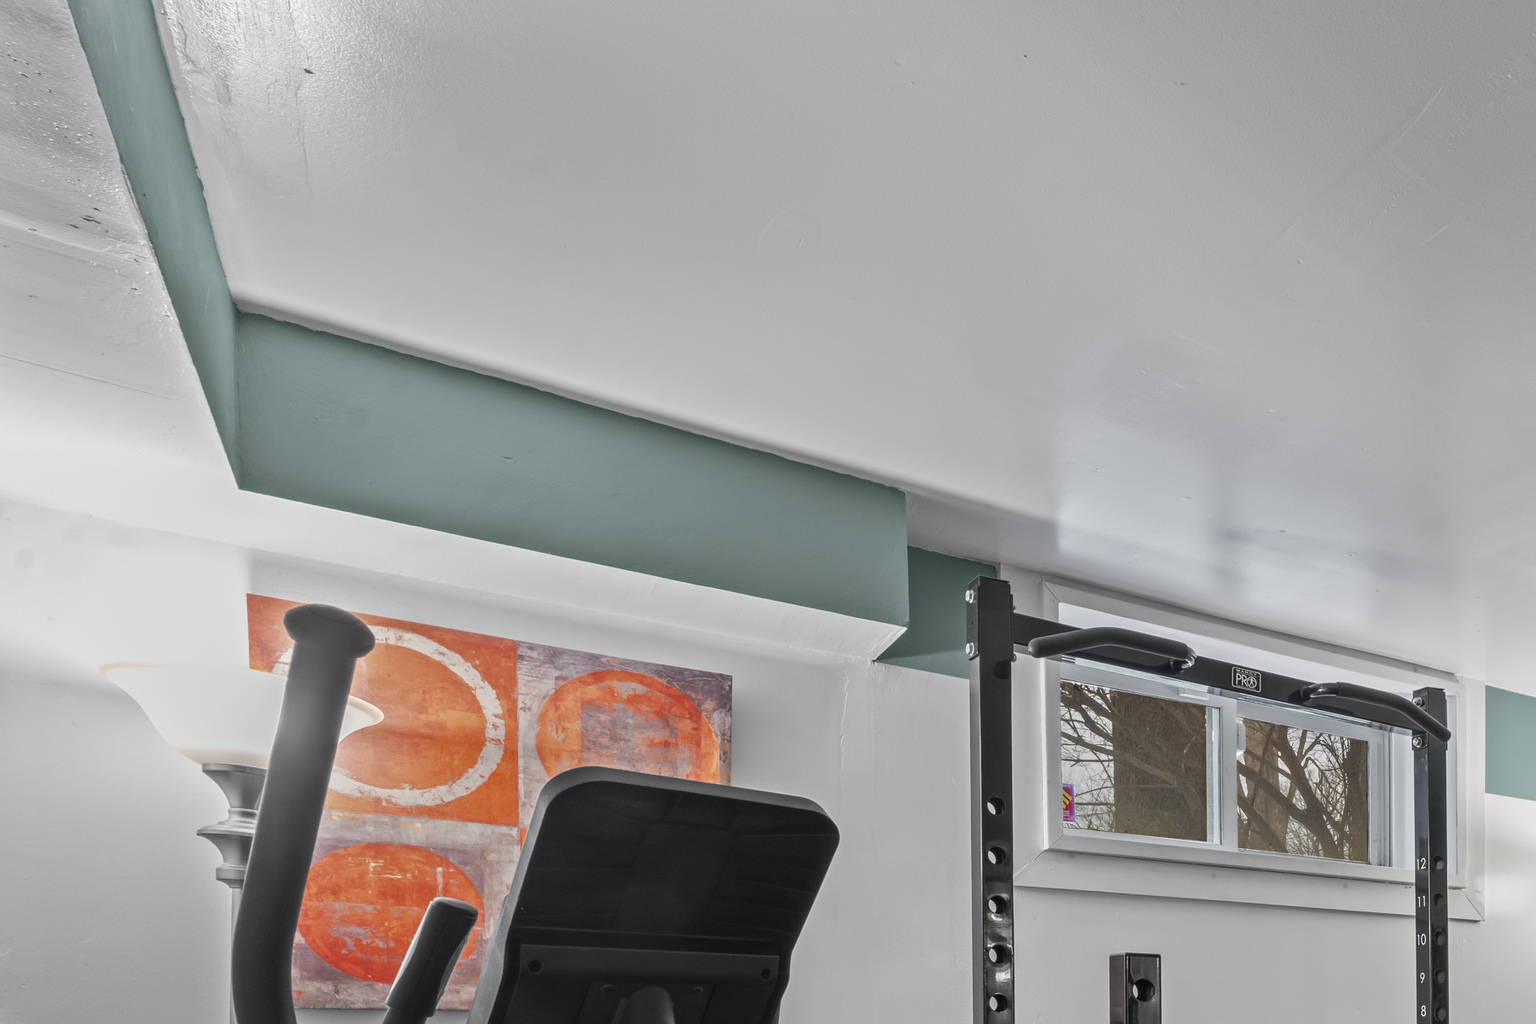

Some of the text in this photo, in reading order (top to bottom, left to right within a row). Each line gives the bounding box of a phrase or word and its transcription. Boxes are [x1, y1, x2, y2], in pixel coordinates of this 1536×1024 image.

[1235, 672, 1257, 689] PRO
[1416, 857, 1427, 870] 12
[1417, 895, 1426, 908] 11
[1416, 933, 1427, 946] 10
[1419, 972, 1426, 984] 9
[1420, 1005, 1427, 1017] 8
